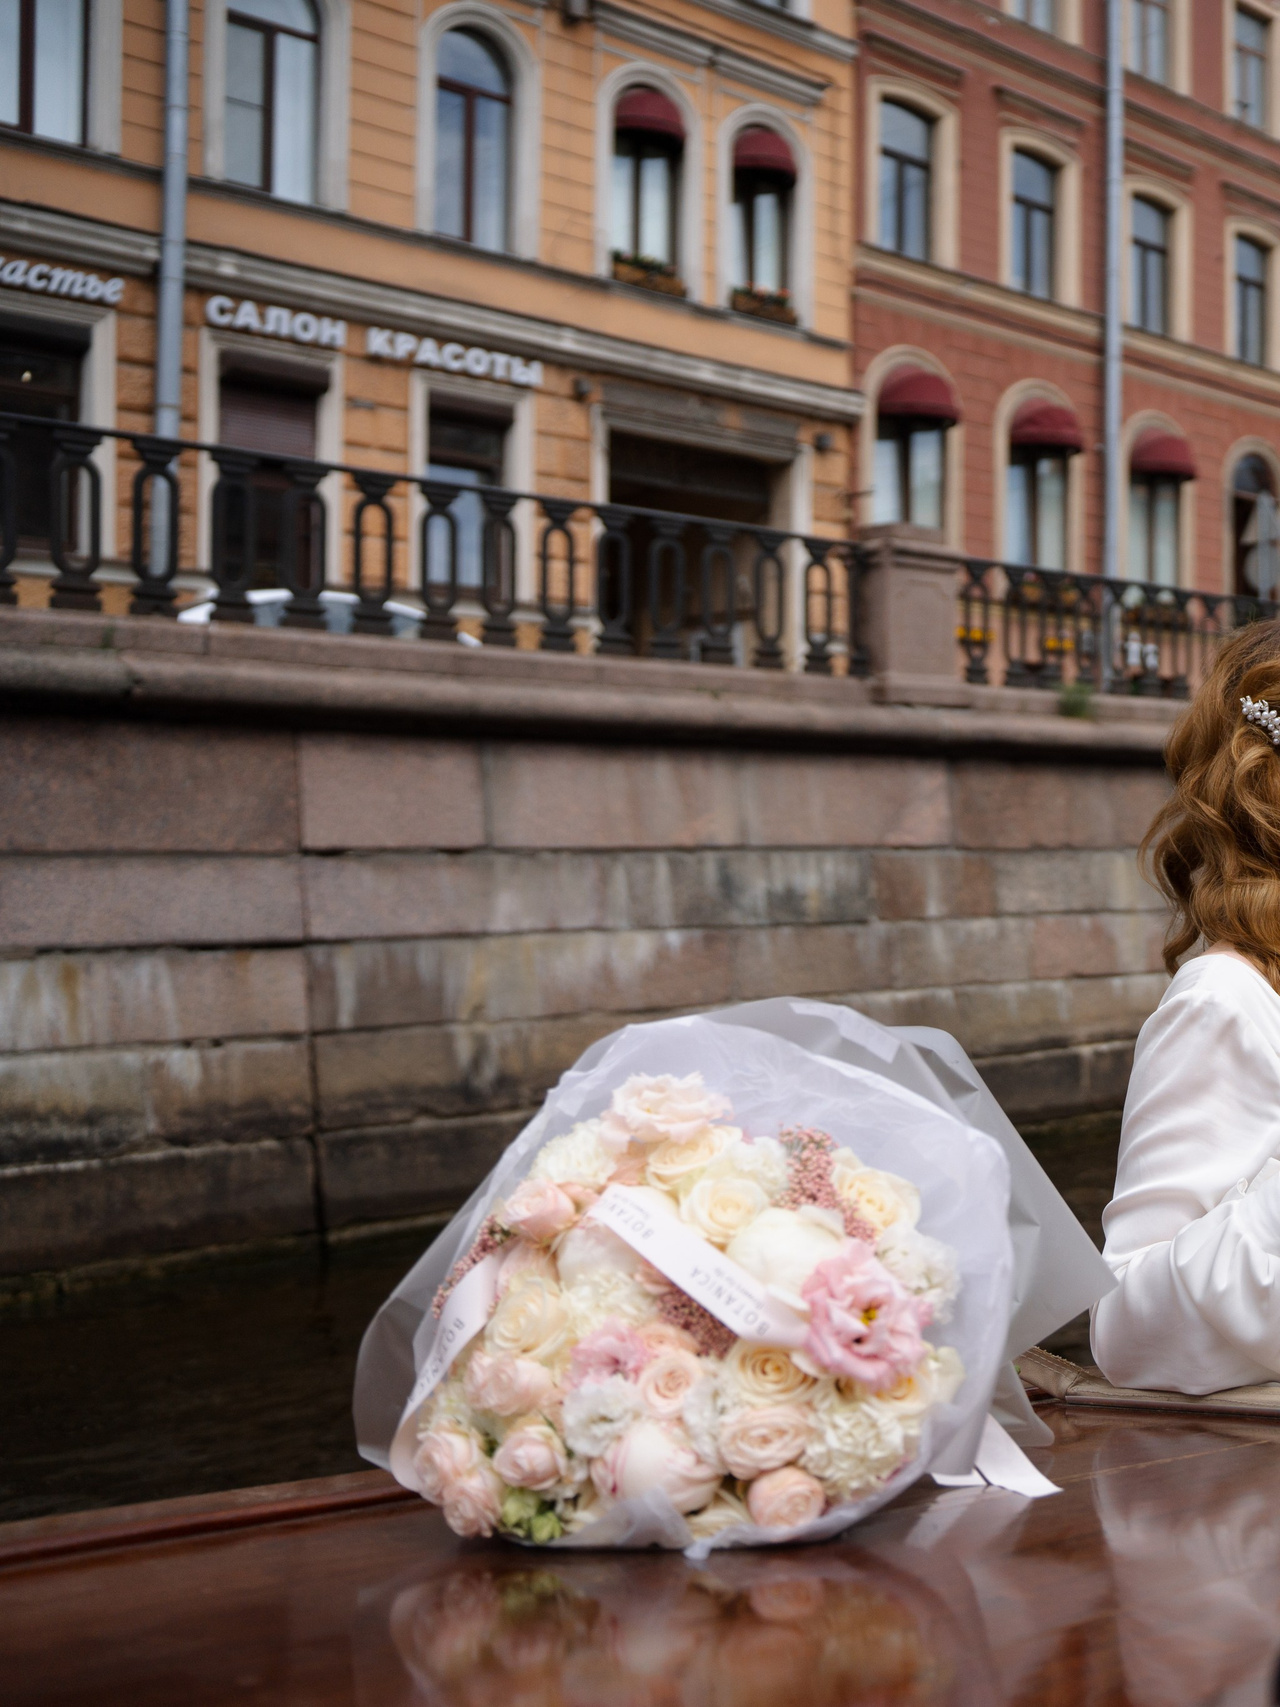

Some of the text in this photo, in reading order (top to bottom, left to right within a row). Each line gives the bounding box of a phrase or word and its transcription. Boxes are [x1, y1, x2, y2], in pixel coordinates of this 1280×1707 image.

[0, 256, 125, 303] астье
[205, 295, 544, 387] САЛОН КРАСОТЫ
[690, 1267, 770, 1336] BOTANICA
